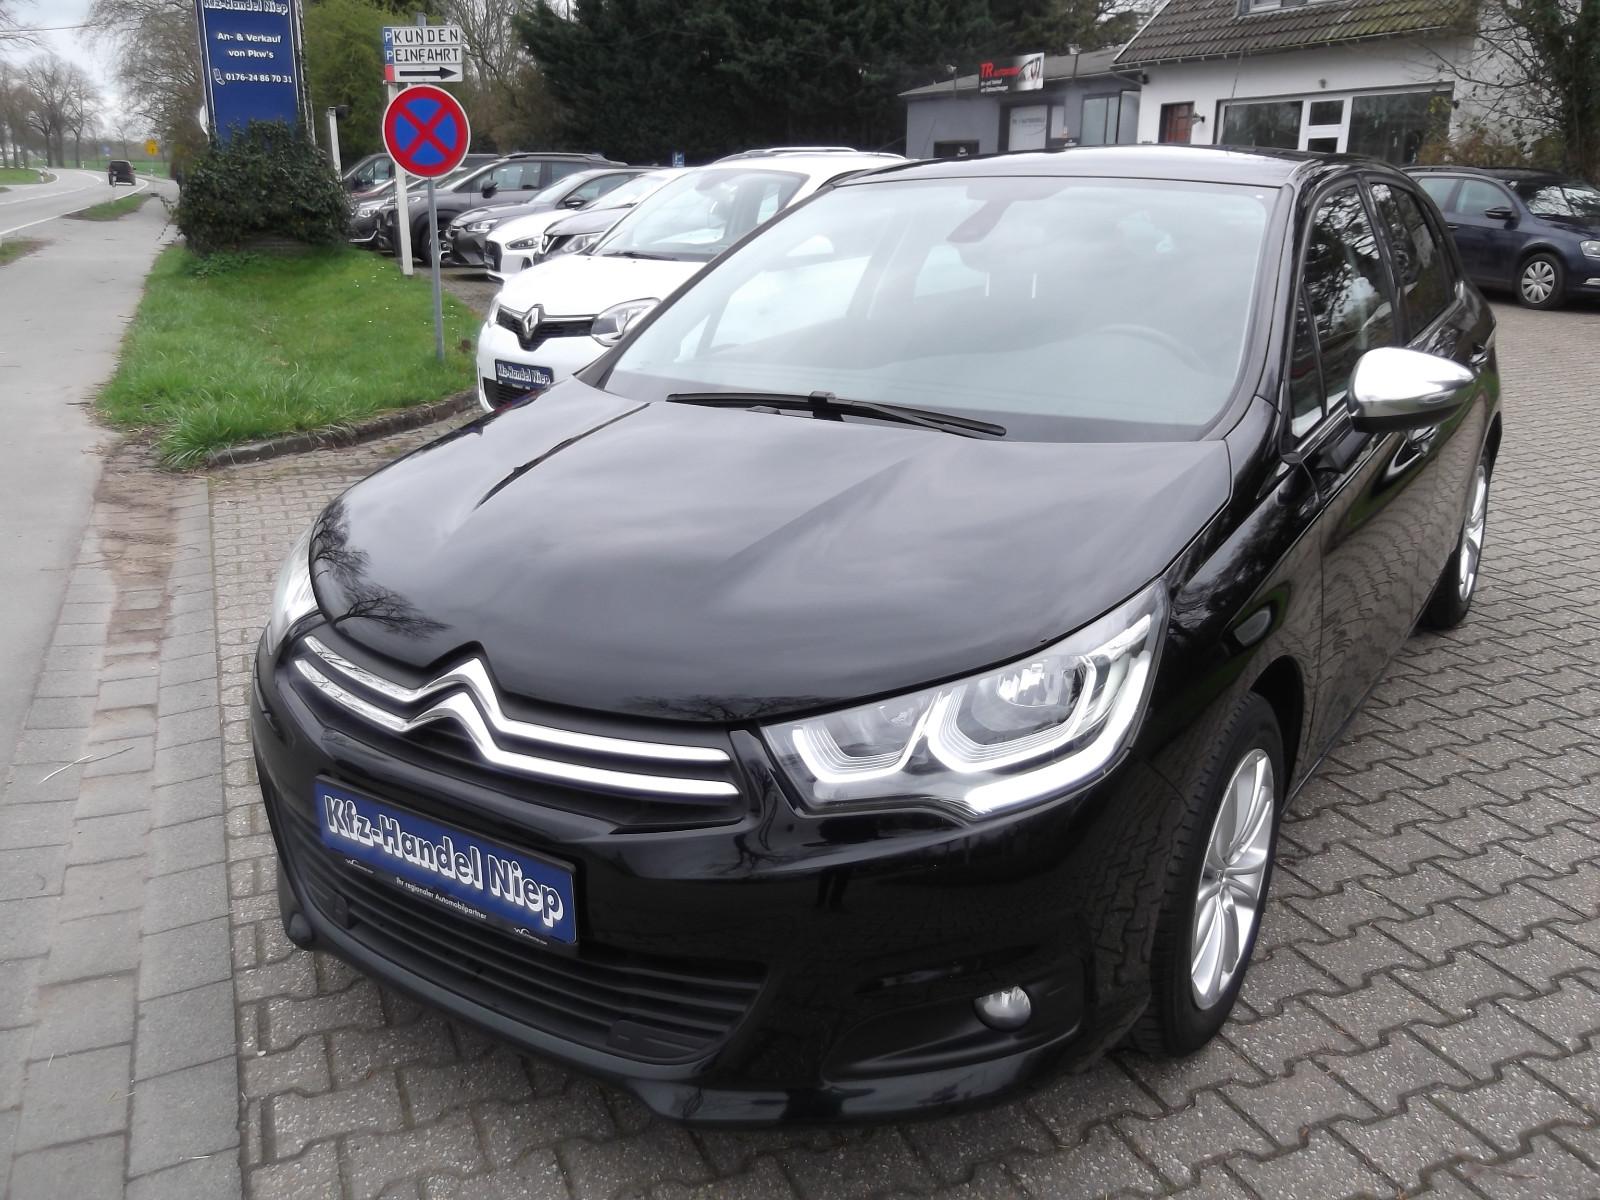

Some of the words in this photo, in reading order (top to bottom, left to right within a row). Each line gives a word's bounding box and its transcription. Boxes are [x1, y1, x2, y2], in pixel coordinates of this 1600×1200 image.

[263, 1, 288, 15] Niep
[217, 32, 234, 41] An-
[236, 33, 244, 41] &
[246, 34, 281, 43] Verkauf
[394, 28, 459, 44] KUNDEN
[248, 50, 274, 58] Pkw's
[395, 48, 459, 62] EINFAHRT
[259, 74, 269, 82] 86
[272, 75, 281, 83] 70
[283, 75, 292, 83] 31
[324, 795, 484, 890] Kfz-Handel
[488, 855, 564, 928] Niep
[405, 883, 434, 898] regionaler
[435, 893, 487, 920] Automobilpartner
